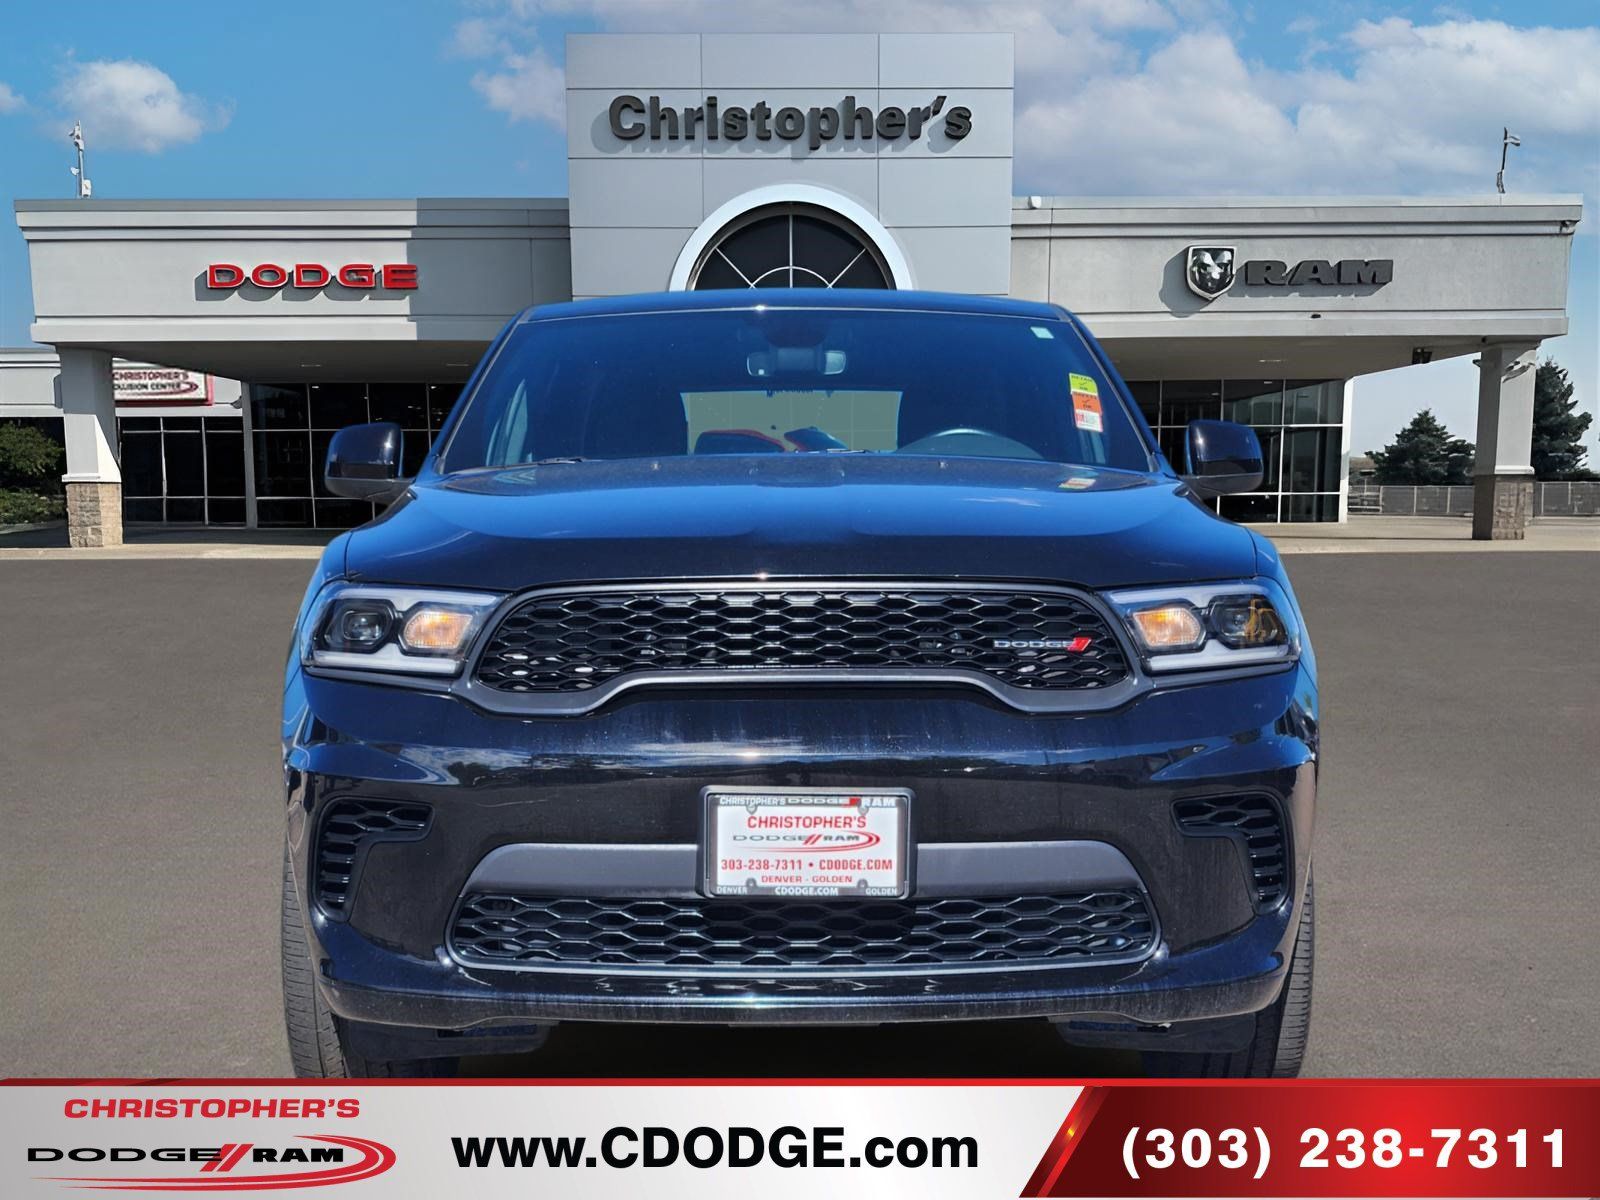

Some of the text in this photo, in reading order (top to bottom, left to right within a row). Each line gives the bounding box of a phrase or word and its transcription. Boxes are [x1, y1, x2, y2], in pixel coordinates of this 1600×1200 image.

[609, 95, 972, 150] Christopher's
[207, 264, 418, 289] DODGE
[1245, 260, 1393, 285] RAM
[994, 640, 1073, 648] DODGE
[719, 797, 785, 806] CHRISTOPHER'S
[861, 797, 896, 807] RAM
[747, 816, 866, 828] CHRISTOPHER'S
[733, 834, 806, 842] DODGE
[721, 859, 893, 870] 303-238-7311 CDODGE.COM
[761, 875, 802, 883] DENVER
[812, 875, 852, 883] GOLDEN
[716, 886, 747, 894] DENVER
[775, 886, 838, 895] CDODGE.COM
[865, 887, 897, 895] GOLDEN
